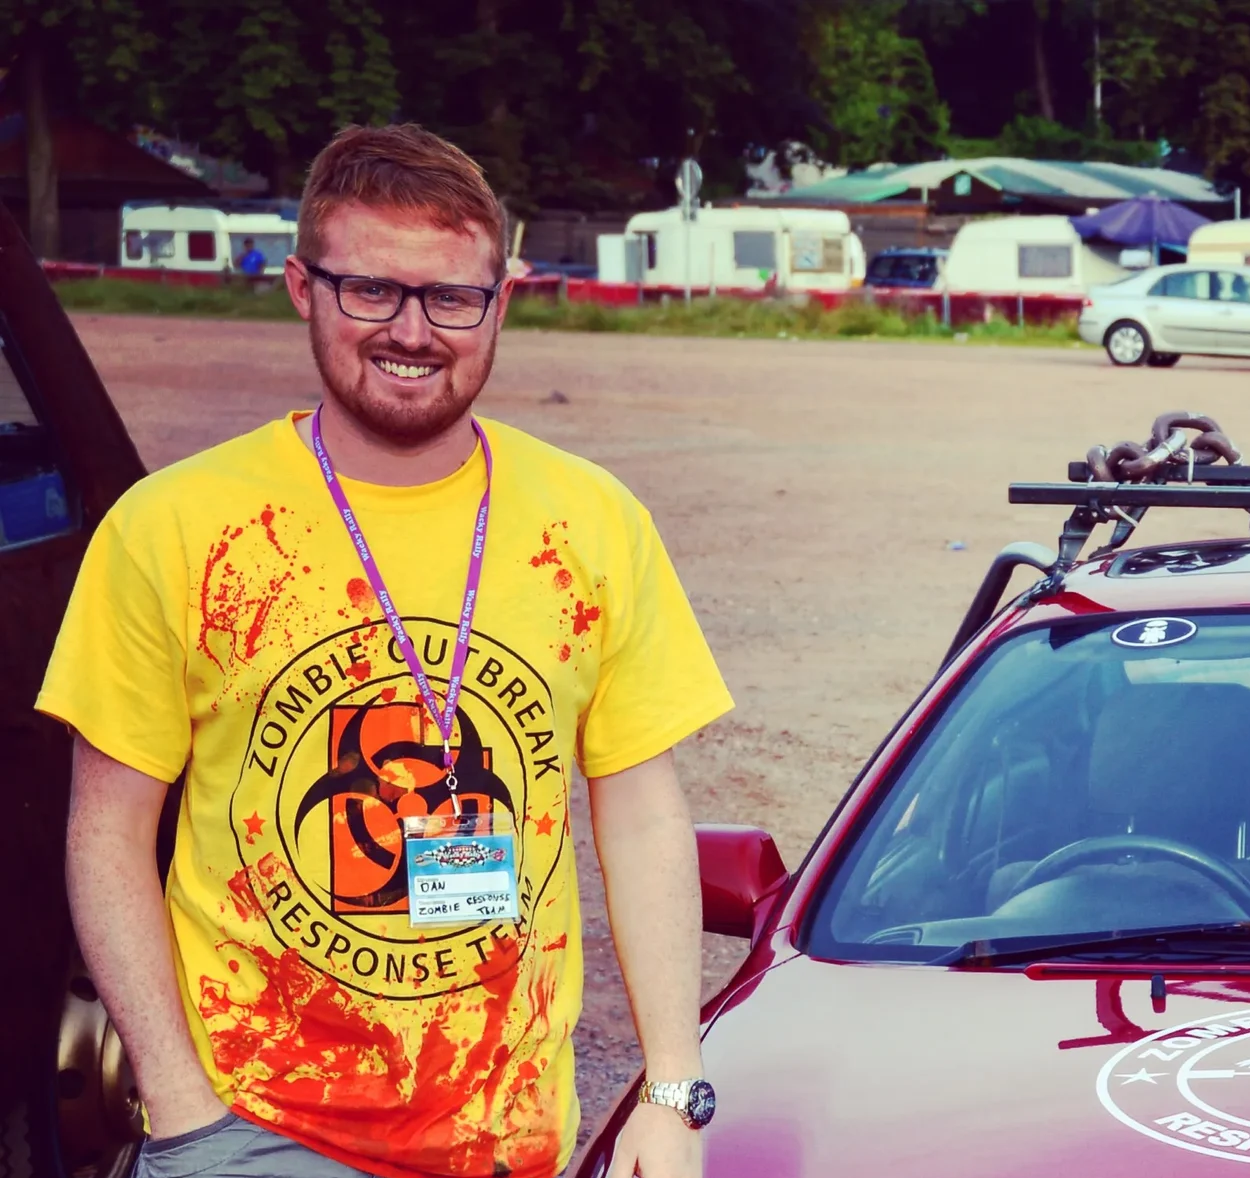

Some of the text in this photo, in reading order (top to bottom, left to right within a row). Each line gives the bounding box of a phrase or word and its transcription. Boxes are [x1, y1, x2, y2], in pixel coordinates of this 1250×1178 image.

[343, 508, 371, 562] Wacky Rally
[472, 506, 488, 559] Wacky Rally
[379, 590, 407, 645] Wacky Rally
[458, 589, 476, 645] Wacky Rally
[249, 642, 368, 778] ZOMBIE
[446, 675, 461, 705] Wacky
[418, 902, 460, 916] ZOMBIE
[420, 881, 446, 893] DAN
[266, 880, 458, 984] RESPONSE
